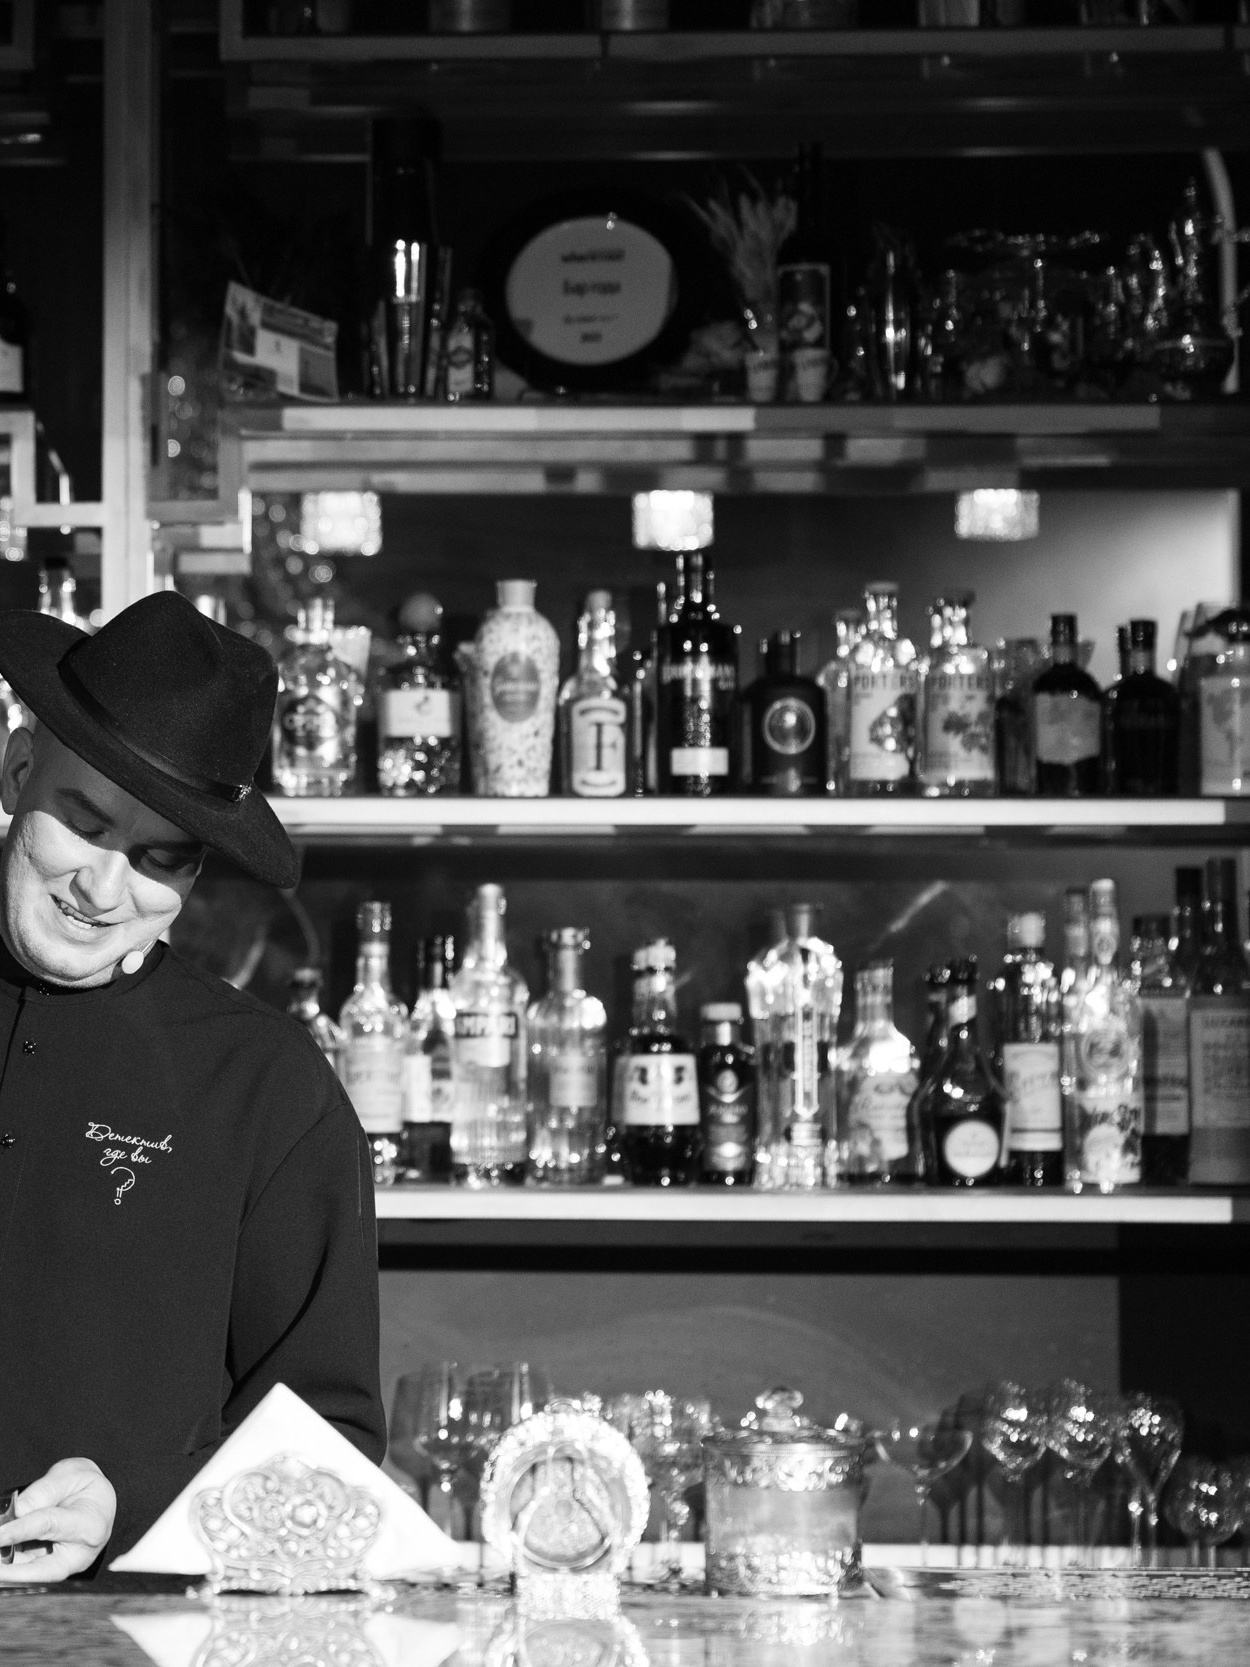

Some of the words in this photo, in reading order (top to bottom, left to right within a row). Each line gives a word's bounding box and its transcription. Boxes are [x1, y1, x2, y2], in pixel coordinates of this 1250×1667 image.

[85, 1121, 173, 1154] Детектив,
[99, 1147, 128, 1167] где
[130, 1145, 152, 1164] вы
